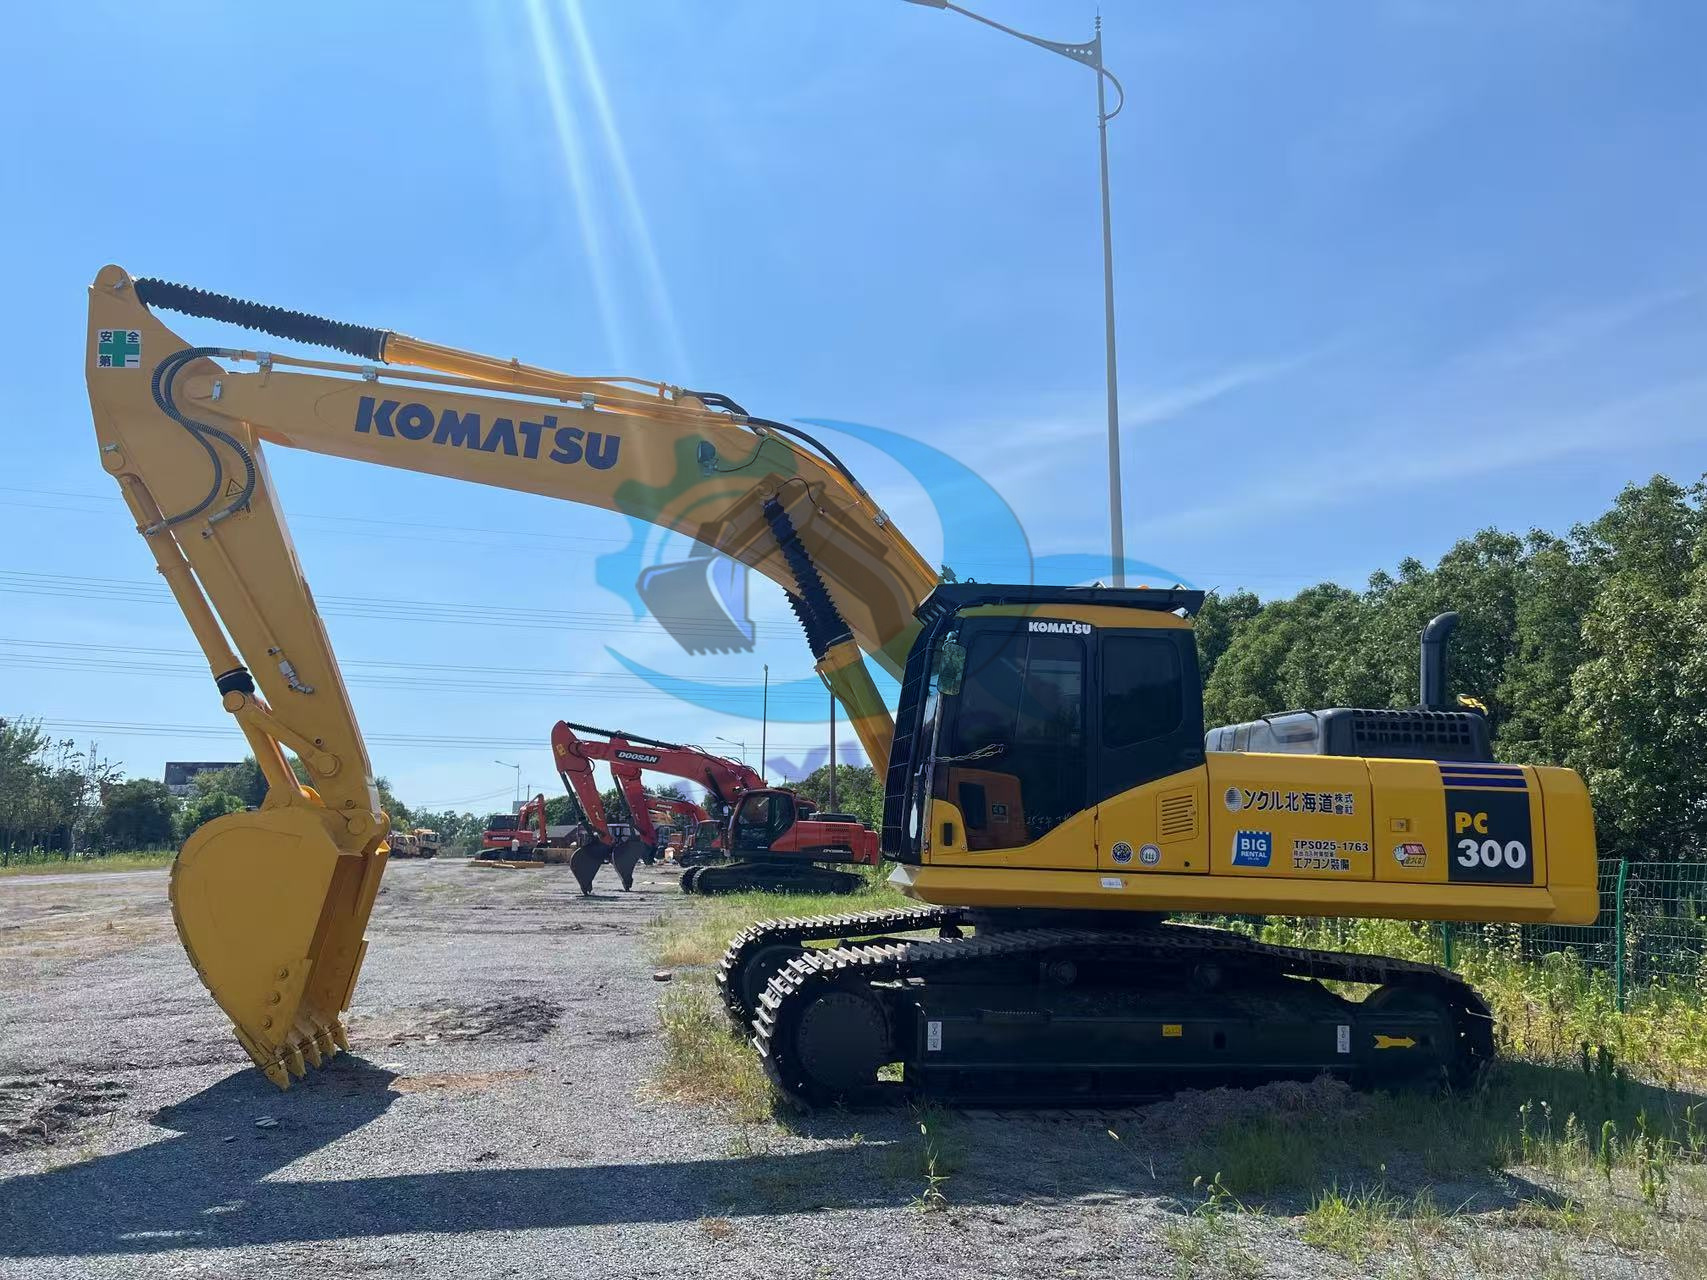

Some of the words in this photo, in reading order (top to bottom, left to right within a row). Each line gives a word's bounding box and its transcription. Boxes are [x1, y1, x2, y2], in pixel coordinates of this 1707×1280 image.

[354, 396, 621, 470] KOMATSU
[1028, 621, 1091, 635] KOMATSU
[618, 751, 658, 763] DOOSAN
[1455, 811, 1489, 834] PC
[1241, 838, 1267, 851] BIG
[1294, 840, 1369, 852] TPS025-1763
[1241, 850, 1268, 858] RENTAL
[1457, 838, 1527, 869] 300
